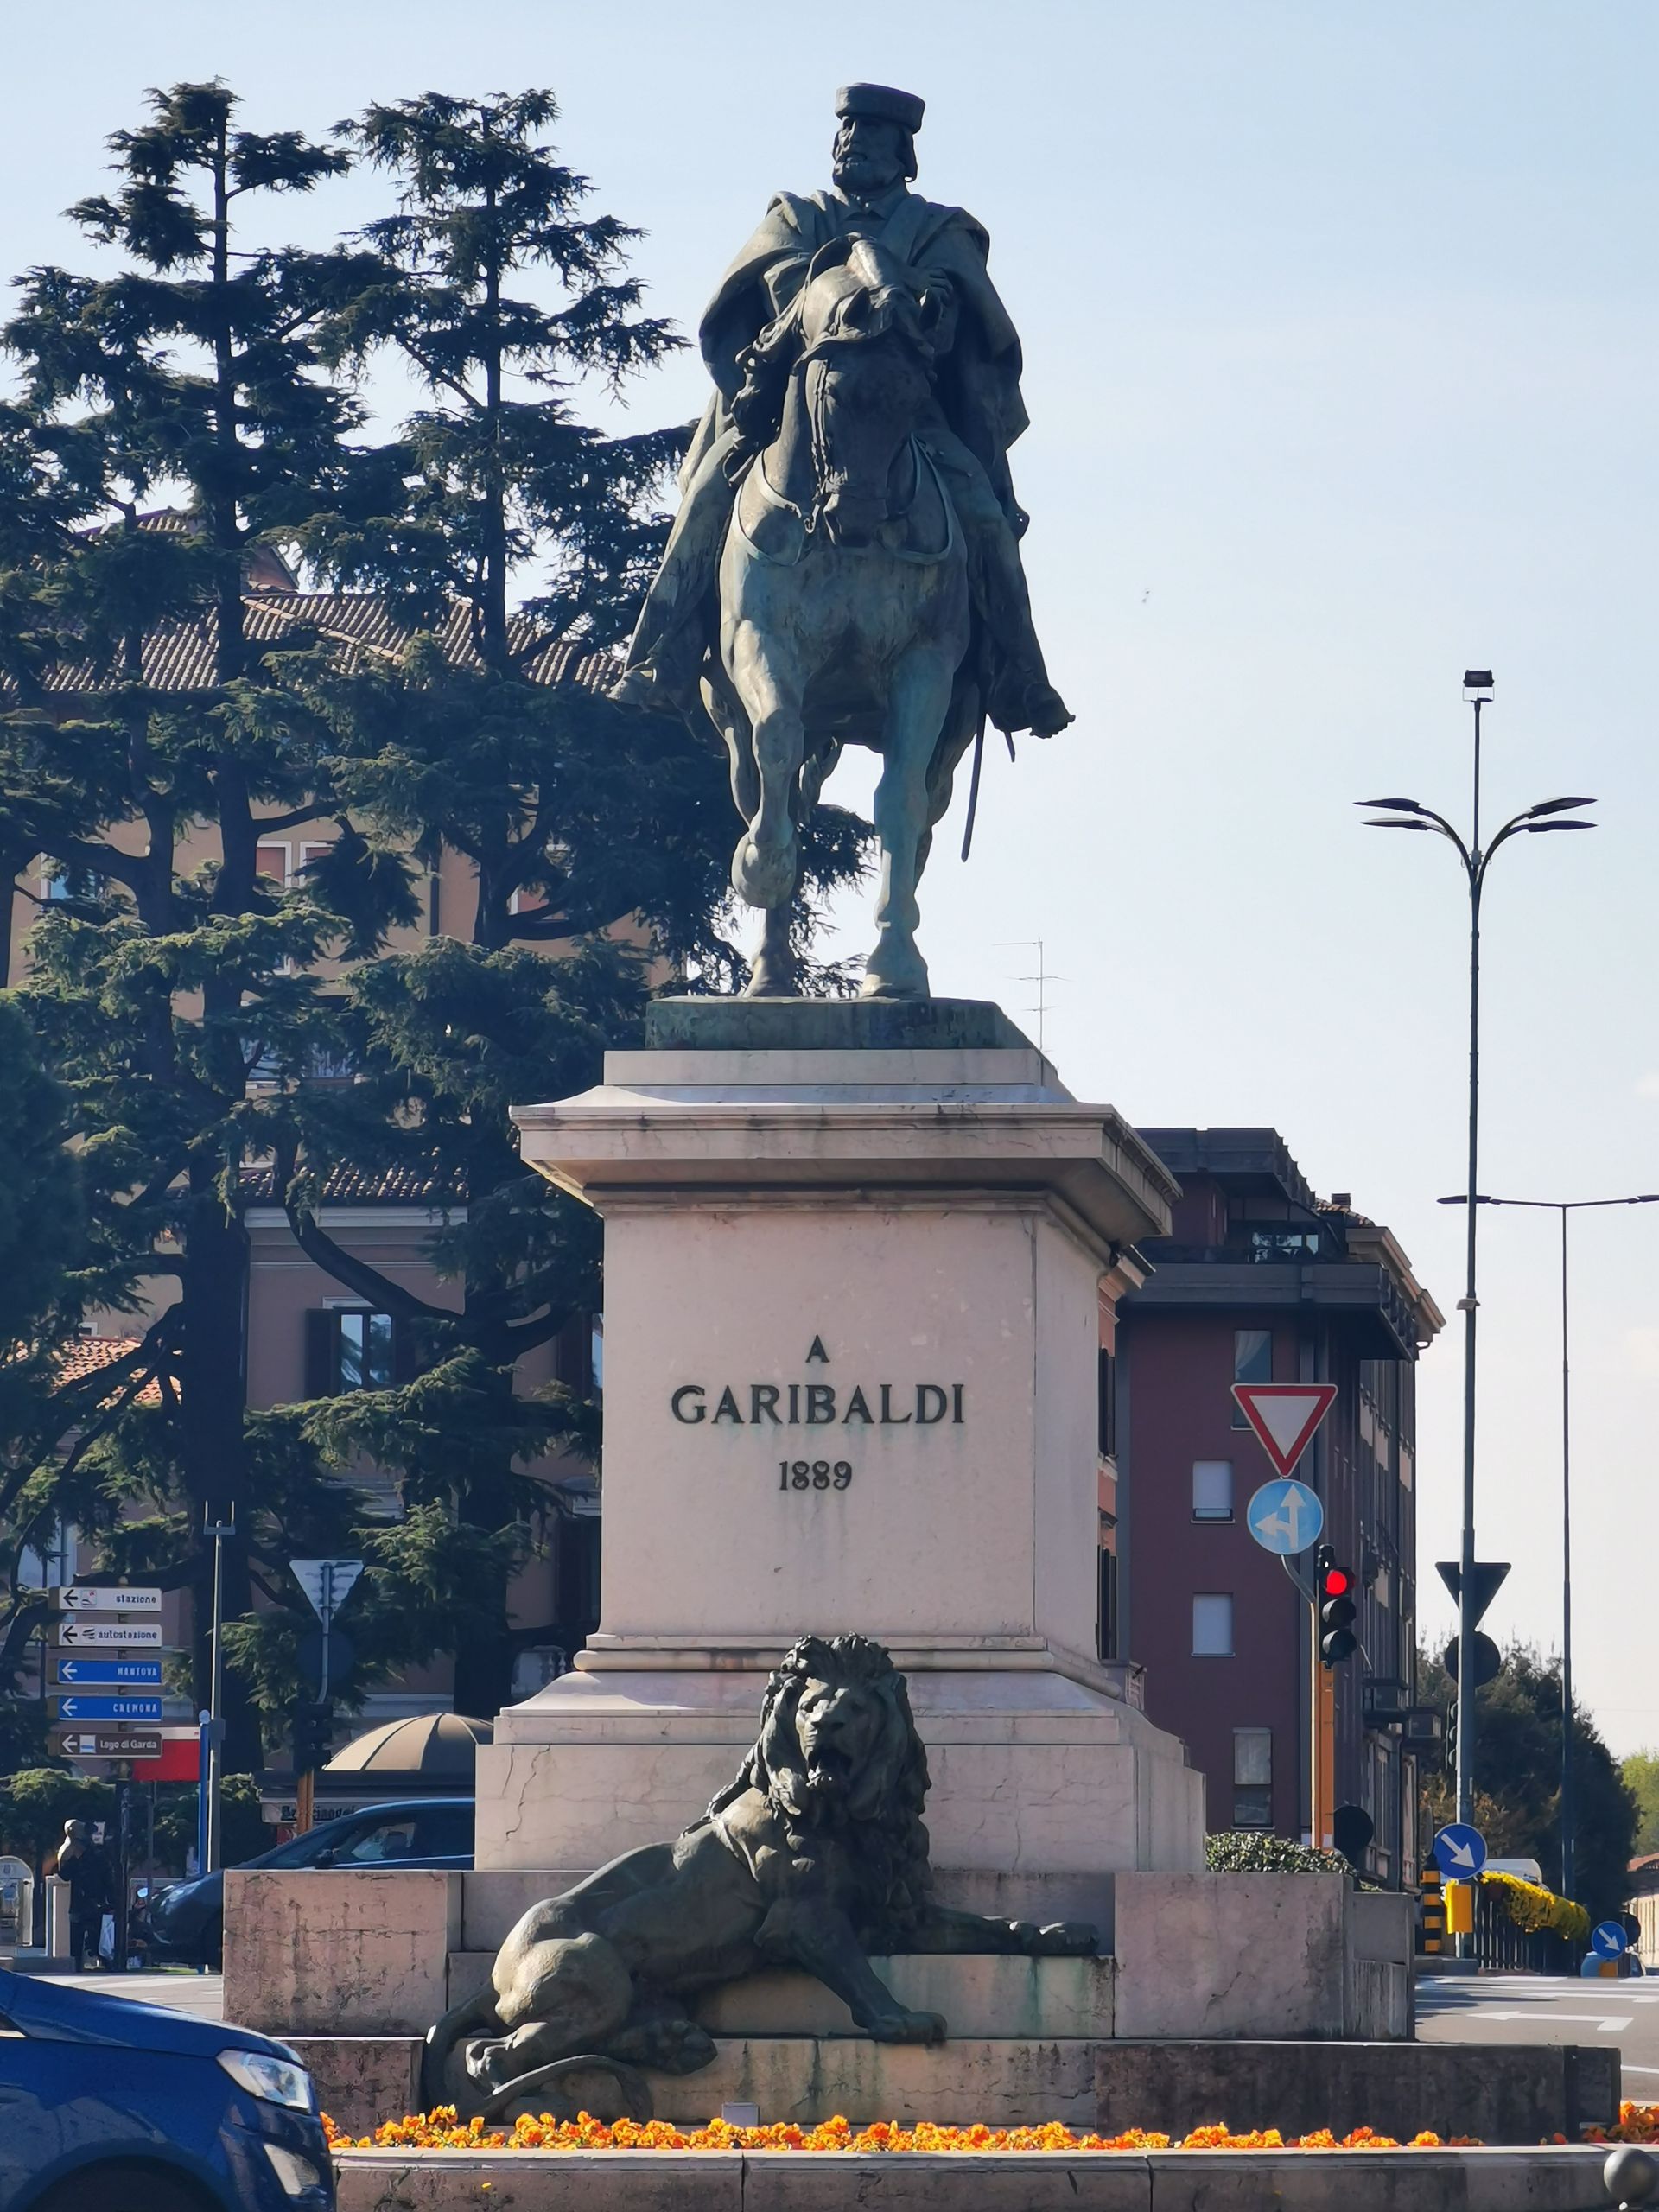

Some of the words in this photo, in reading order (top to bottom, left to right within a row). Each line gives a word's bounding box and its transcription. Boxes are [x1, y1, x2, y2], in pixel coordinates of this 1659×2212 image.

[805, 1334, 830, 1363] A
[671, 1384, 965, 1424] GARIBALDI
[779, 1460, 853, 1491] 1889
[116, 1594, 156, 1604] stazione
[98, 1630, 157, 1639] autostazione
[117, 1667, 157, 1676] MANTOVA
[112, 1703, 157, 1713] CREMONA
[99, 1739, 119, 1751] Lago
[120, 1739, 130, 1749] di
[130, 1739, 157, 1749] Garda
